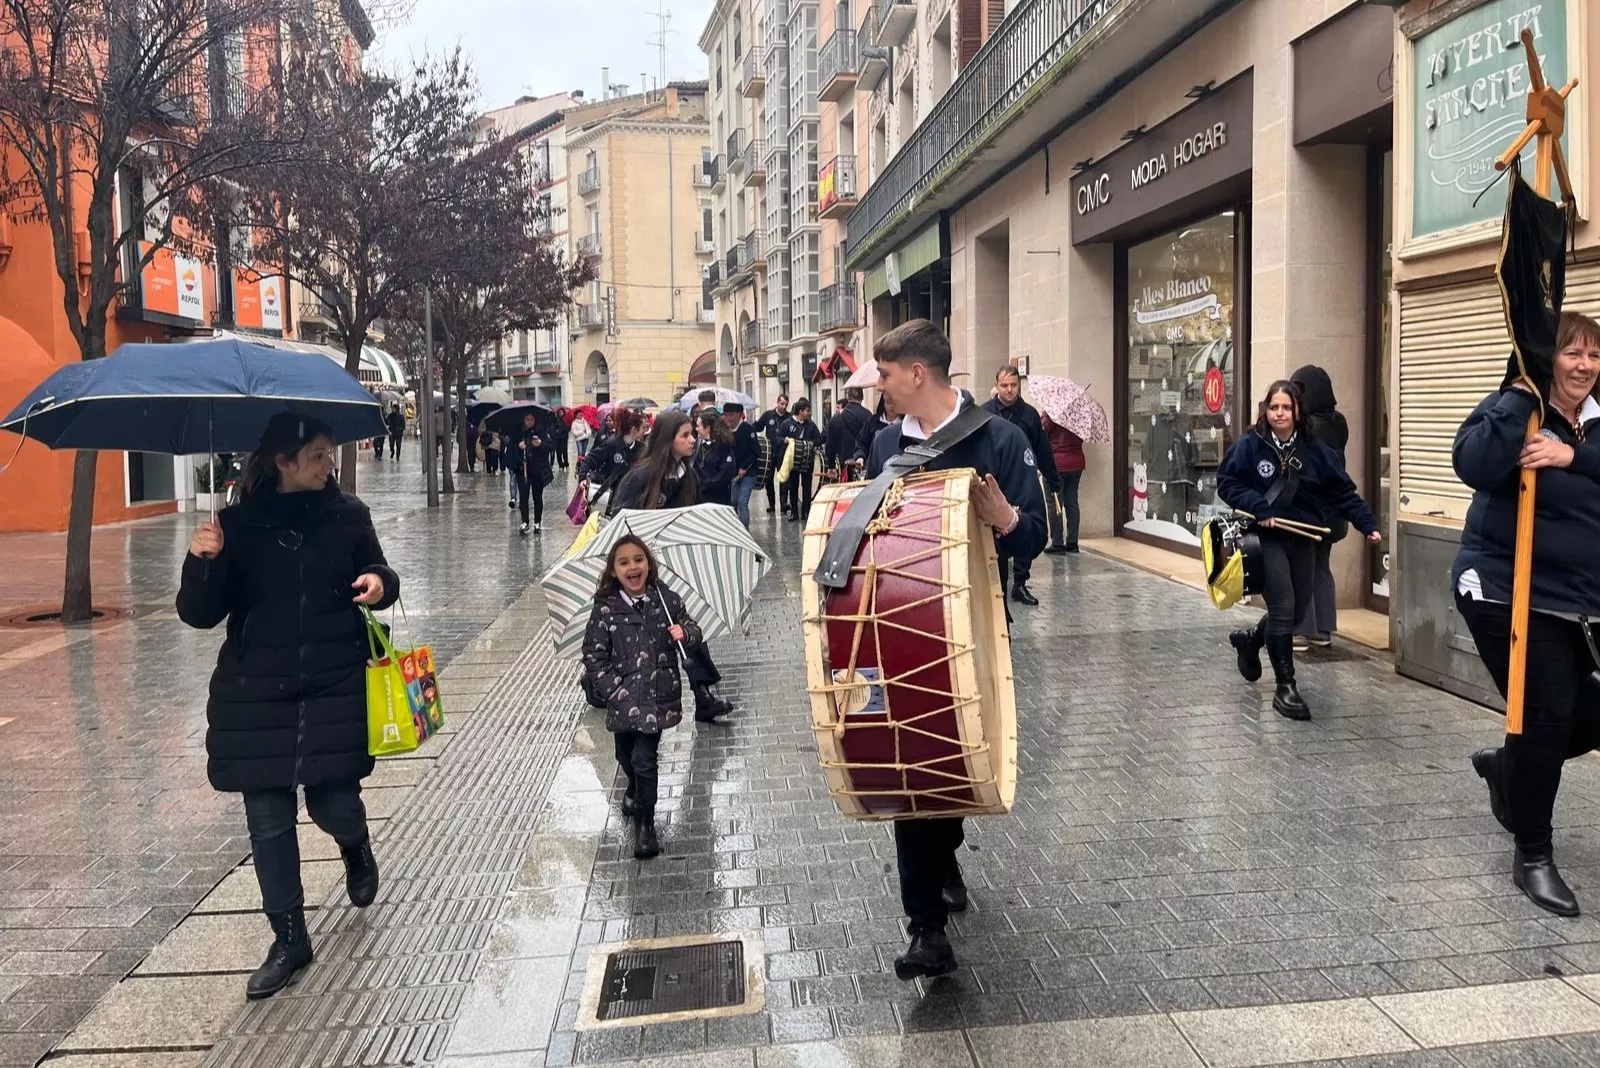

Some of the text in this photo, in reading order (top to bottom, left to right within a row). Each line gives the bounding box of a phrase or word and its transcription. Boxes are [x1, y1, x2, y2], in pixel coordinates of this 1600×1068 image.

[1077, 122, 1226, 215] CMC MODA HOGAR
[1468, 156, 1492, 175] 1947
[181, 294, 201, 306] REPSOL
[1142, 275, 1212, 307] Mes Blanco
[1166, 325, 1183, 340] CMC
